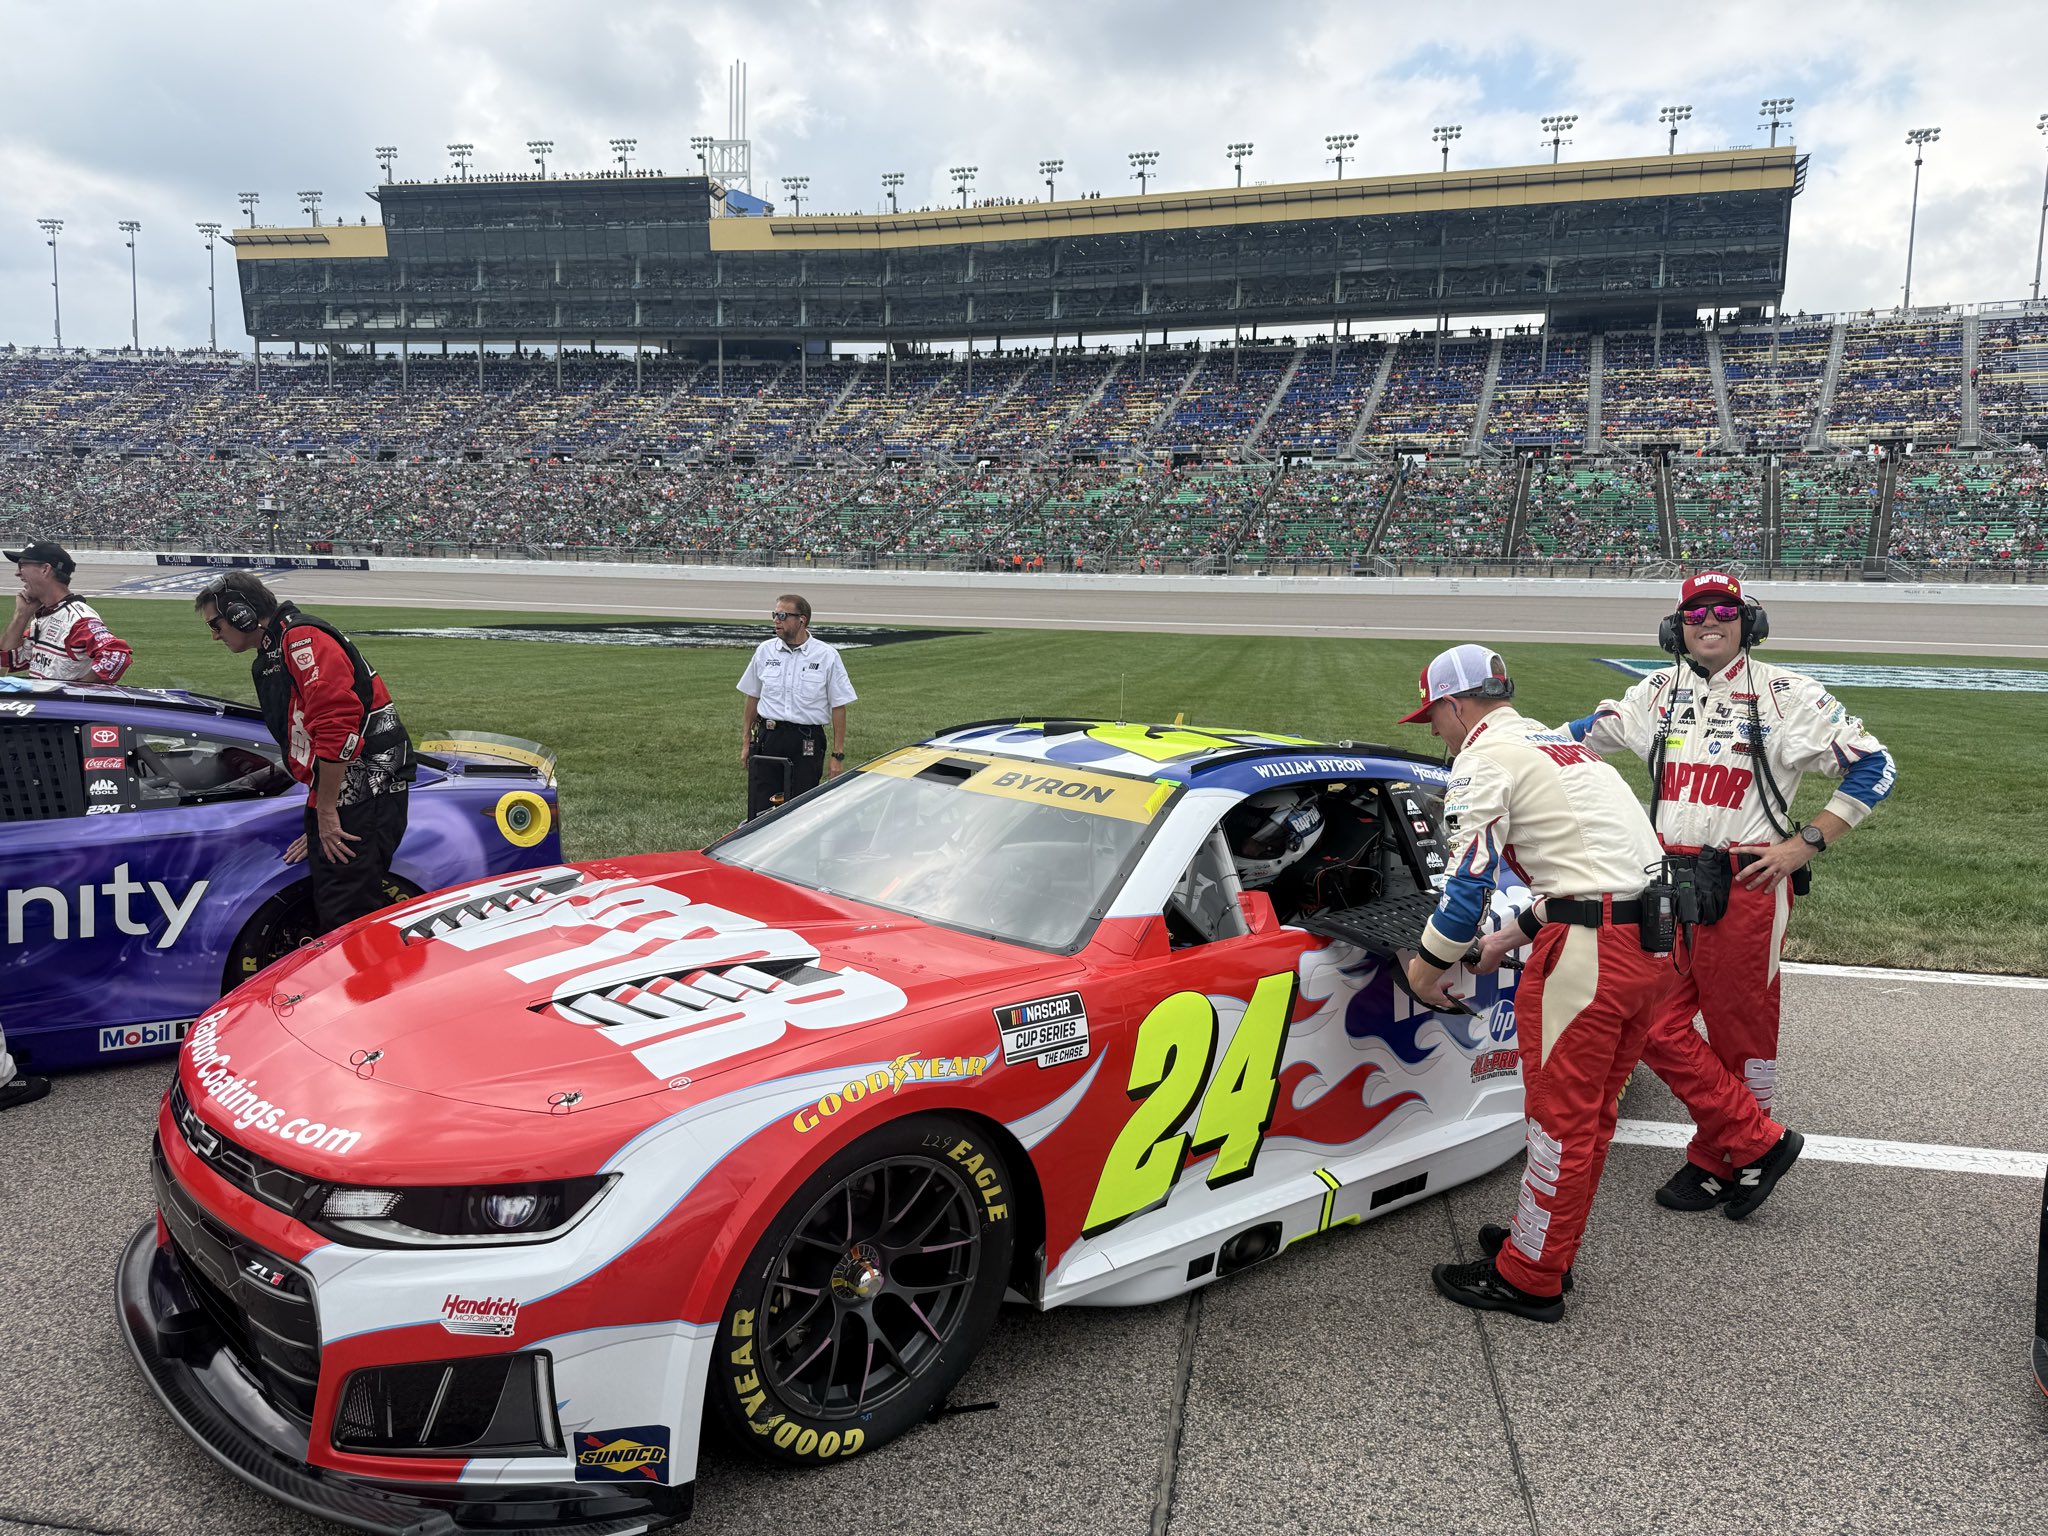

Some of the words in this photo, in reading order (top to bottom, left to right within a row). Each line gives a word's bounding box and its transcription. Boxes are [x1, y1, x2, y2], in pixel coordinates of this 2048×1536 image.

[1694, 574, 1729, 586] RAPTOR
[1728, 584, 1738, 593] 24
[291, 637, 312, 649] NASCAR
[1252, 760, 1316, 779] WILLIAM
[1315, 759, 1366, 773] BYRON
[90, 779, 118, 791] MAC
[992, 771, 1115, 803] BYRON
[1660, 762, 1753, 810] APTOR
[1026, 999, 1071, 1023] NASCAR
[1490, 1000, 1514, 1042] hp
[103, 1024, 170, 1048] Mobil
[1016, 1030, 1038, 1049] CUP
[1039, 1021, 1076, 1043] SERIES
[1044, 1052, 1059, 1065] THE
[1059, 1046, 1084, 1061] CHASE
[1474, 1050, 1519, 1075] ALL-PRO
[185, 1008, 362, 1154] RaptorCoatings.com
[793, 1056, 987, 1133] GOODYEAR
[1081, 970, 1299, 1240] 24
[947, 1139, 1008, 1222] EAGLE
[1510, 1117, 1562, 1261] RAPTOR
[246, 1260, 284, 1285] ZL1
[441, 1294, 519, 1319] Hendrick
[454, 1314, 515, 1323] MOTORSPORTS
[731, 1307, 865, 1457] GOODYEAR
[582, 1447, 664, 1464] SUNOCO
